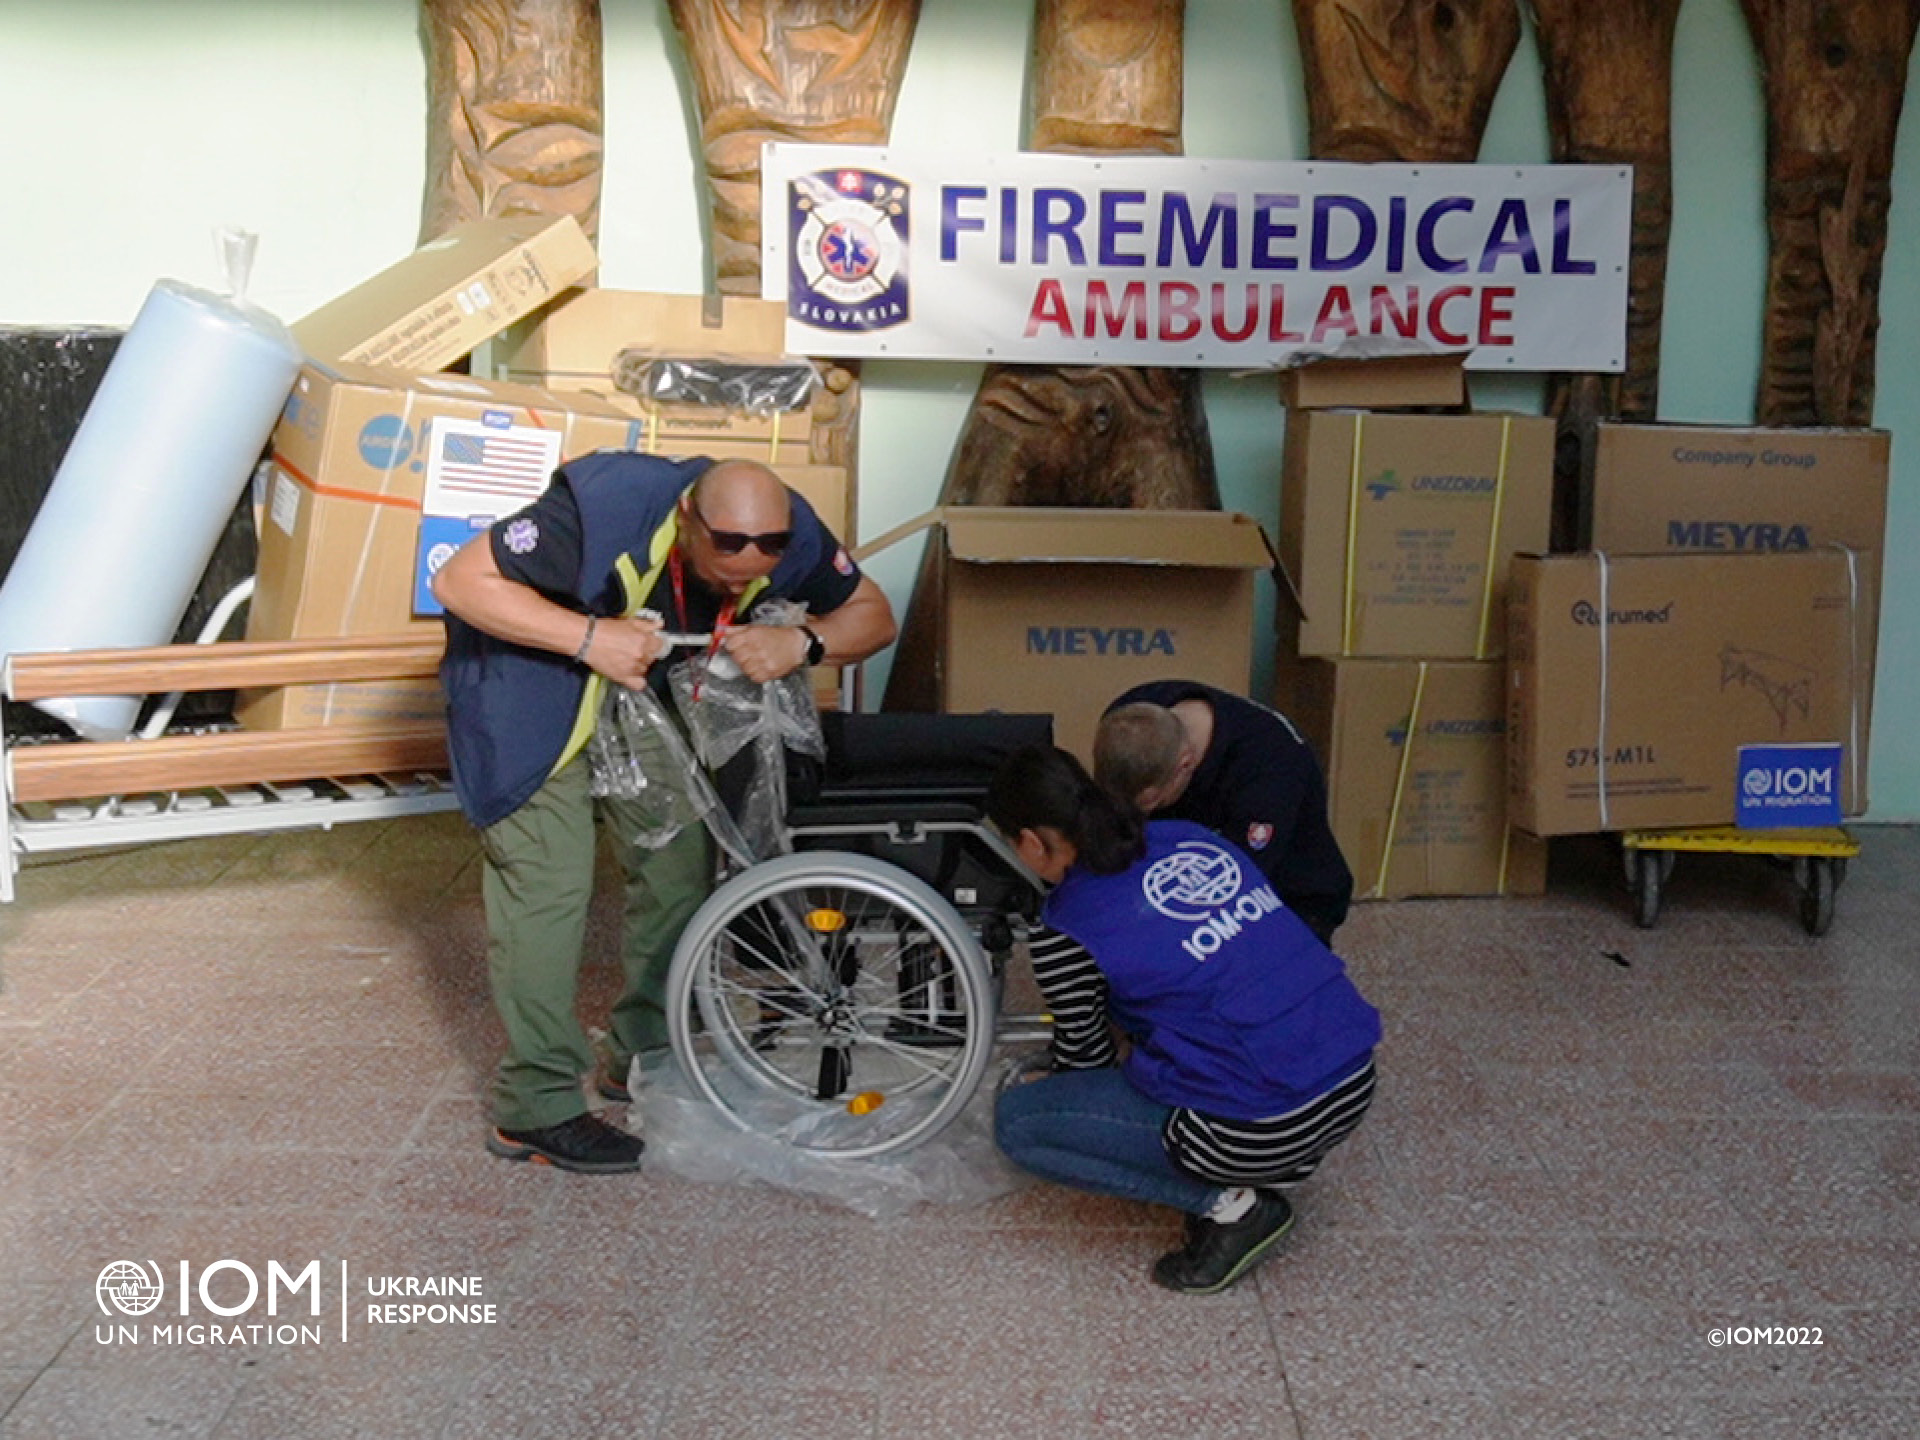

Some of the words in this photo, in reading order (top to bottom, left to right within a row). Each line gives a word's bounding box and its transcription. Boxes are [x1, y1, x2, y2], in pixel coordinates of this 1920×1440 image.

[939, 184, 1597, 275] FIREMEDICAL
[800, 302, 902, 324] SLOVAKIA
[1023, 278, 1516, 346] AMBULANCE
[1673, 447, 1755, 468] Company
[1761, 450, 1817, 470] Group
[1667, 520, 1810, 552] MEYRA
[1026, 626, 1174, 656] MEYRA
[1774, 766, 1832, 795] IOM
